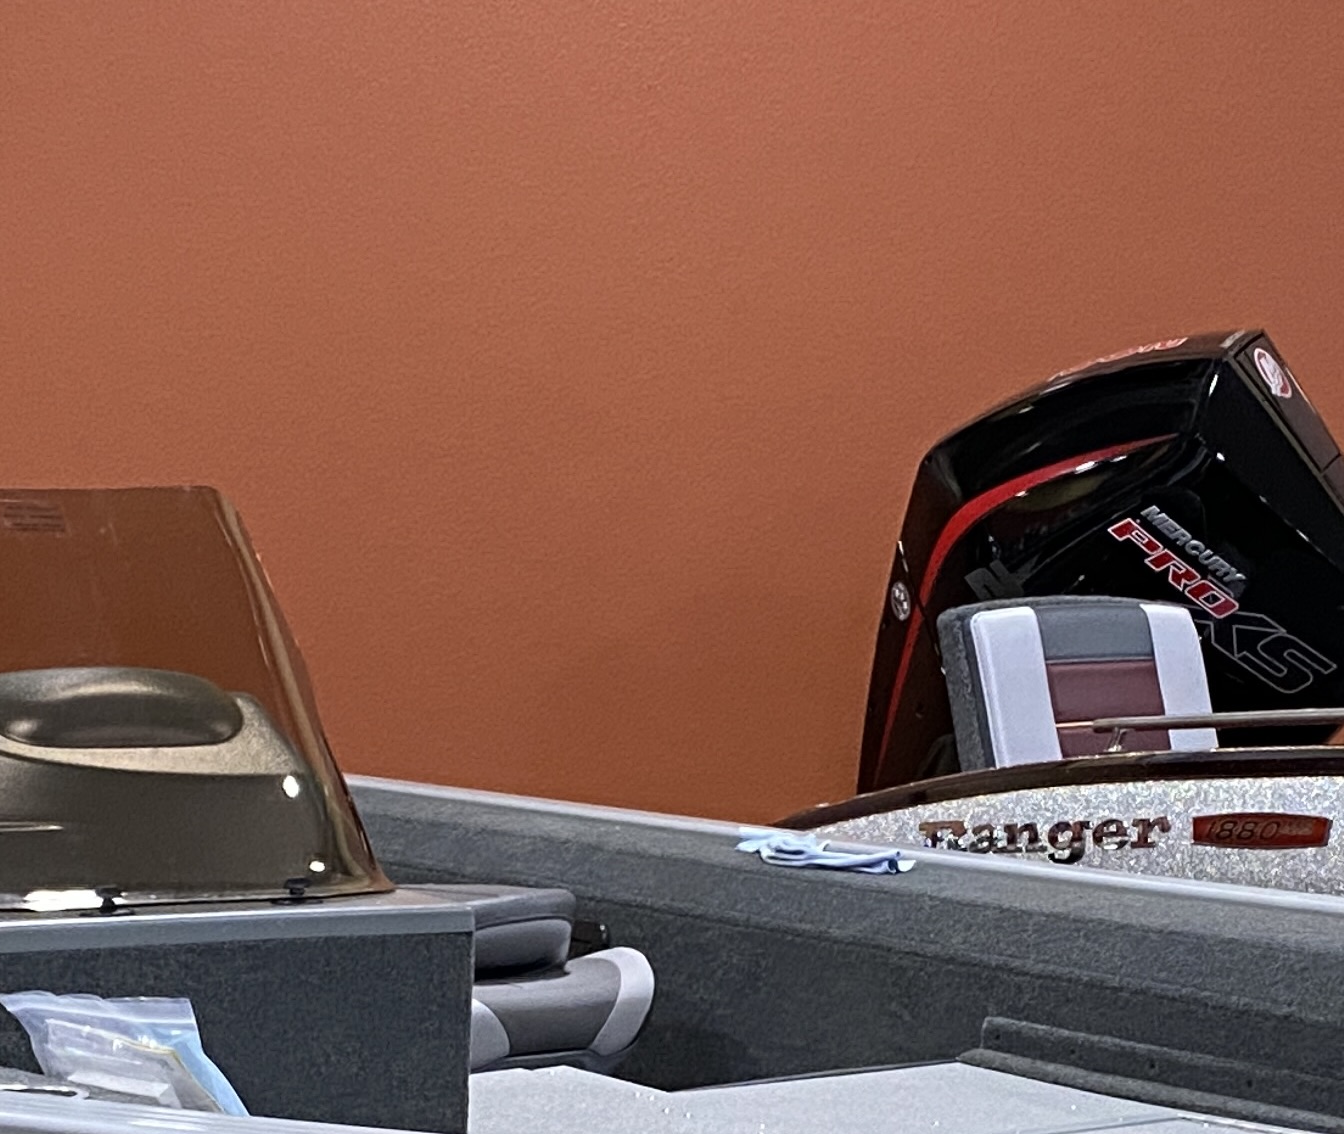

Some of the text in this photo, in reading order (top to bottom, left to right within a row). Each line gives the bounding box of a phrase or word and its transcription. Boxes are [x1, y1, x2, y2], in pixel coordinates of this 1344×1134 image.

[1108, 518, 1240, 619] PRO
[1140, 505, 1247, 582] MERCURY
[1194, 611, 1338, 694] XS
[919, 814, 1173, 864] Ranger
[1206, 819, 1282, 842] 1880
